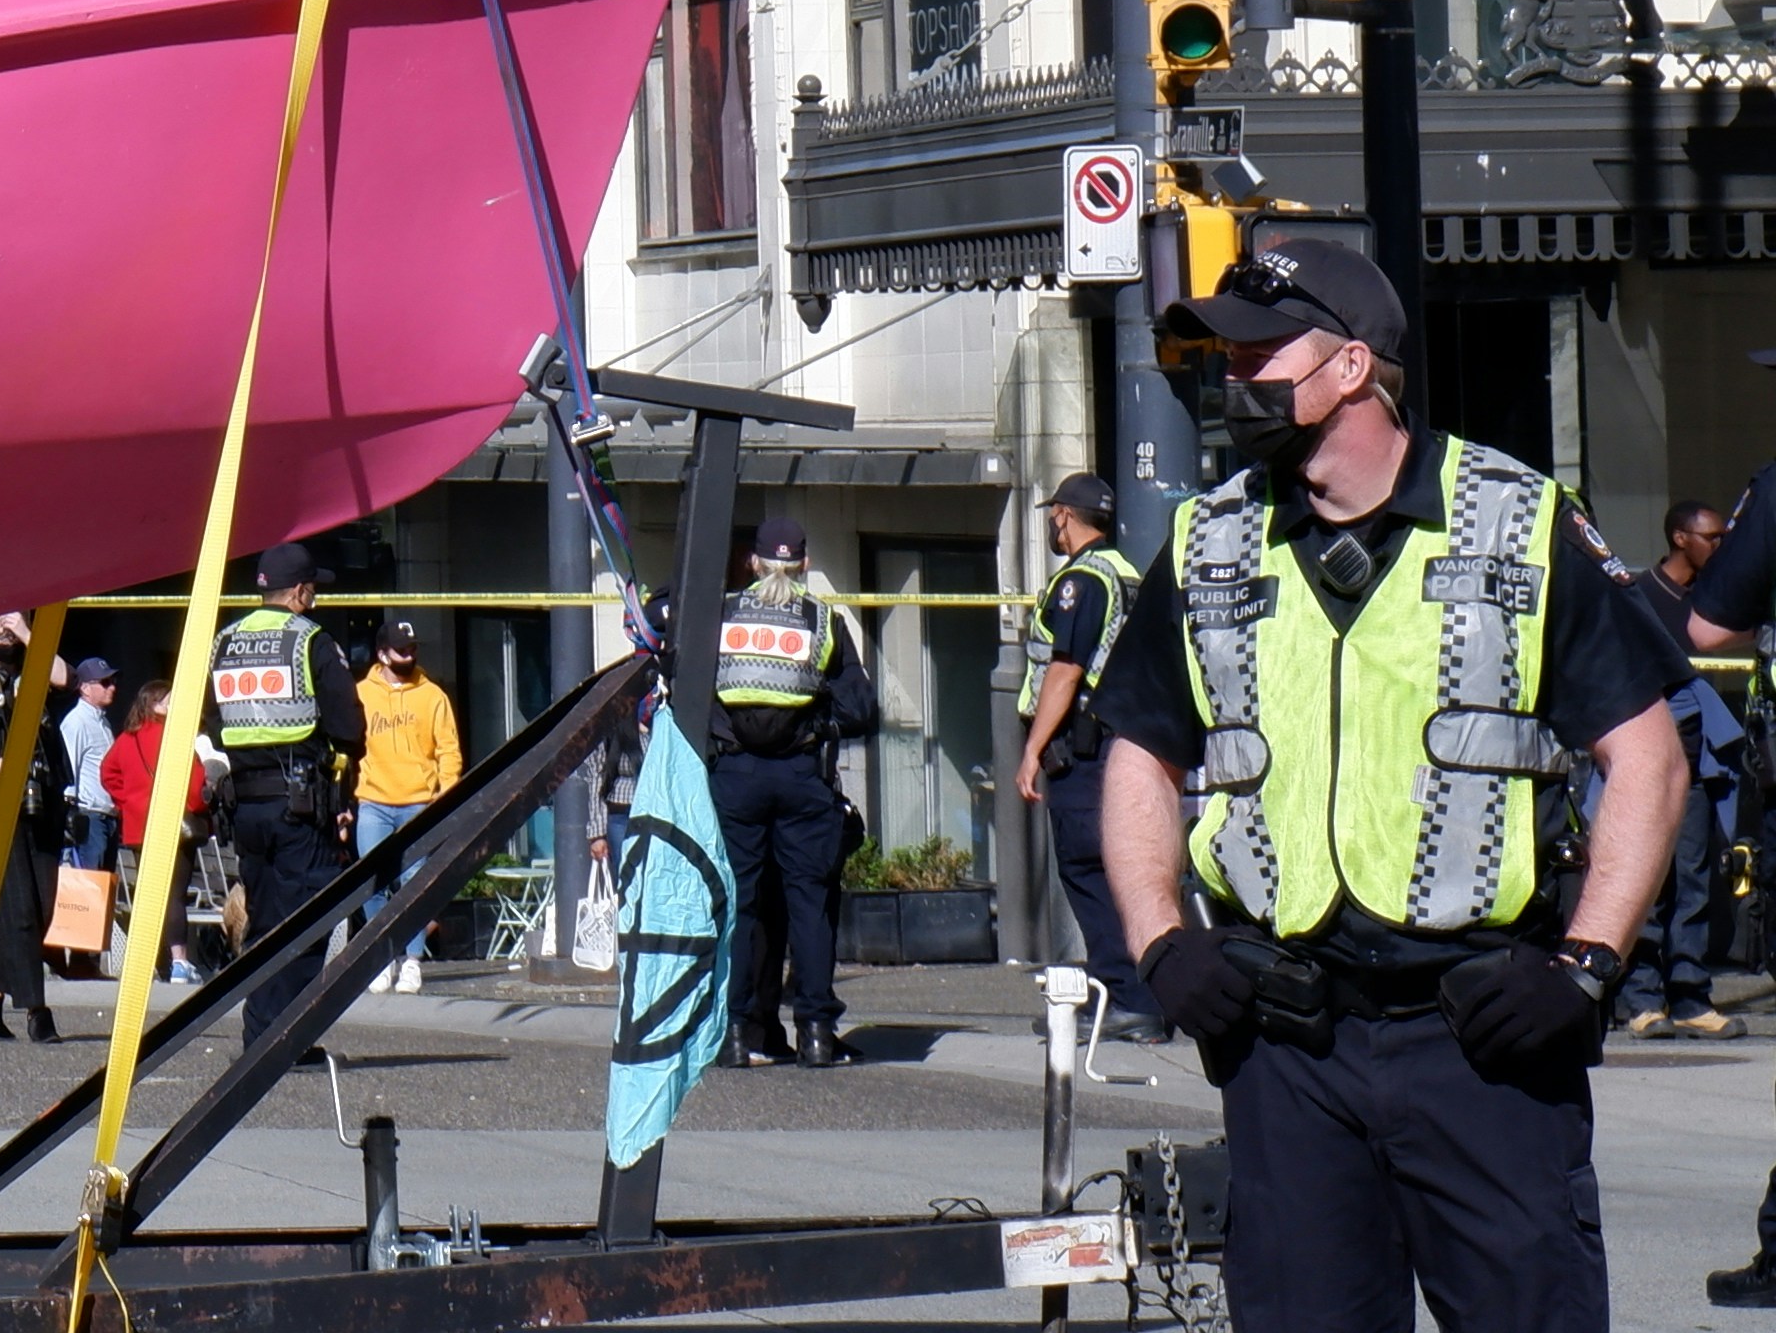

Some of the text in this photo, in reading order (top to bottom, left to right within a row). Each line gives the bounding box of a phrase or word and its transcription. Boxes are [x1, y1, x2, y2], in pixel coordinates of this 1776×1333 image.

[1136, 441, 1155, 458] 40
[1188, 586, 1250, 605] PUBLIC
[1429, 574, 1531, 610] POLICE
[1187, 598, 1268, 626] FETY UNIT
[226, 640, 282, 656] POLICE
